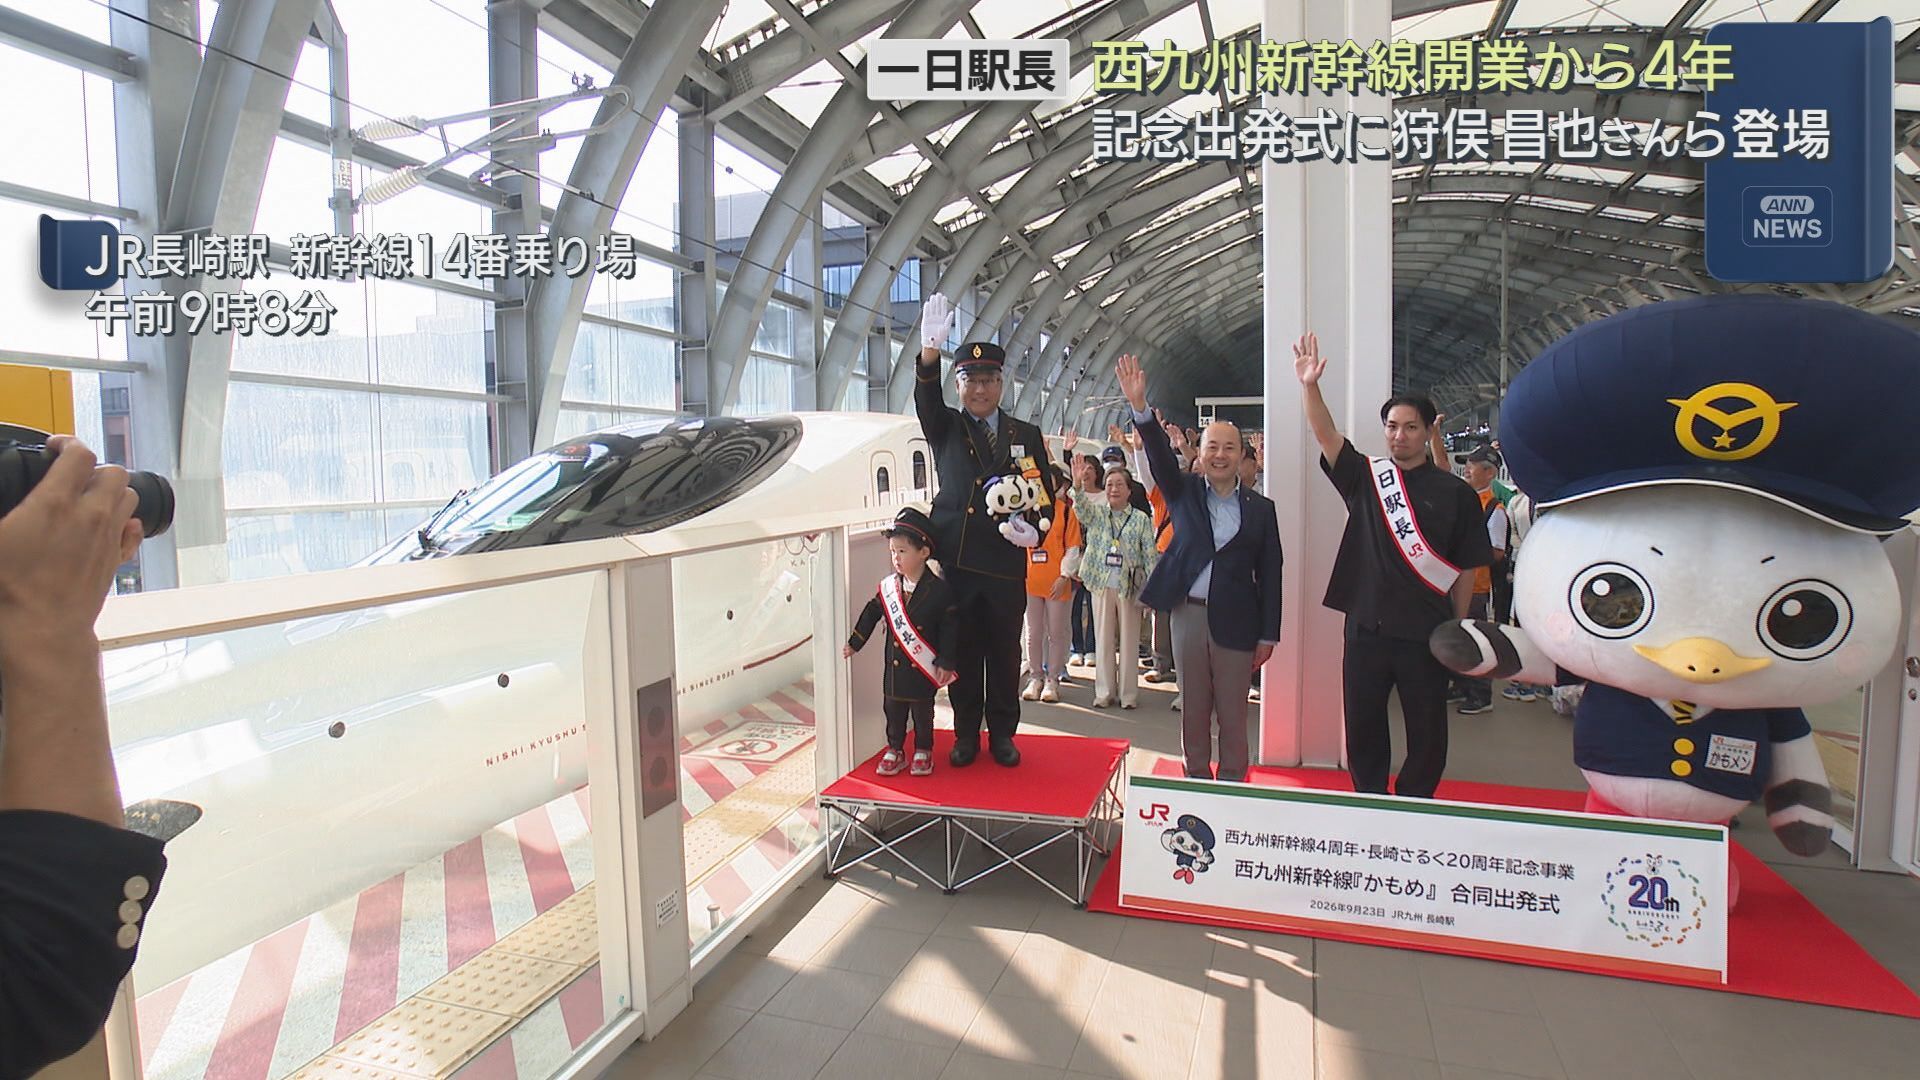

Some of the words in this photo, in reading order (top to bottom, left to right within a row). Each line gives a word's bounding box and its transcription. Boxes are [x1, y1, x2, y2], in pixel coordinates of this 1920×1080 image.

[1372, 457, 1415, 540] 一日駅長
[1408, 542, 1424, 558] JR
[486, 746, 524, 767] NISHI
[530, 727, 577, 751] KYUSHU
[1709, 751, 1752, 771] かもメン
[1139, 803, 1170, 822] JR
[1225, 828, 1576, 882] 西九州新幹線4周年・長崎さるく20周年記念事業
[1235, 858, 1437, 901] 西九州新幹線『かもめ』
[1451, 882, 1561, 916] 合同出発式
[1628, 874, 1681, 913] 20th
[1310, 899, 1385, 919] 2026年9月23日
[1391, 910, 1423, 923] JR九州
[1426, 913, 1456, 927] 長崎駅
